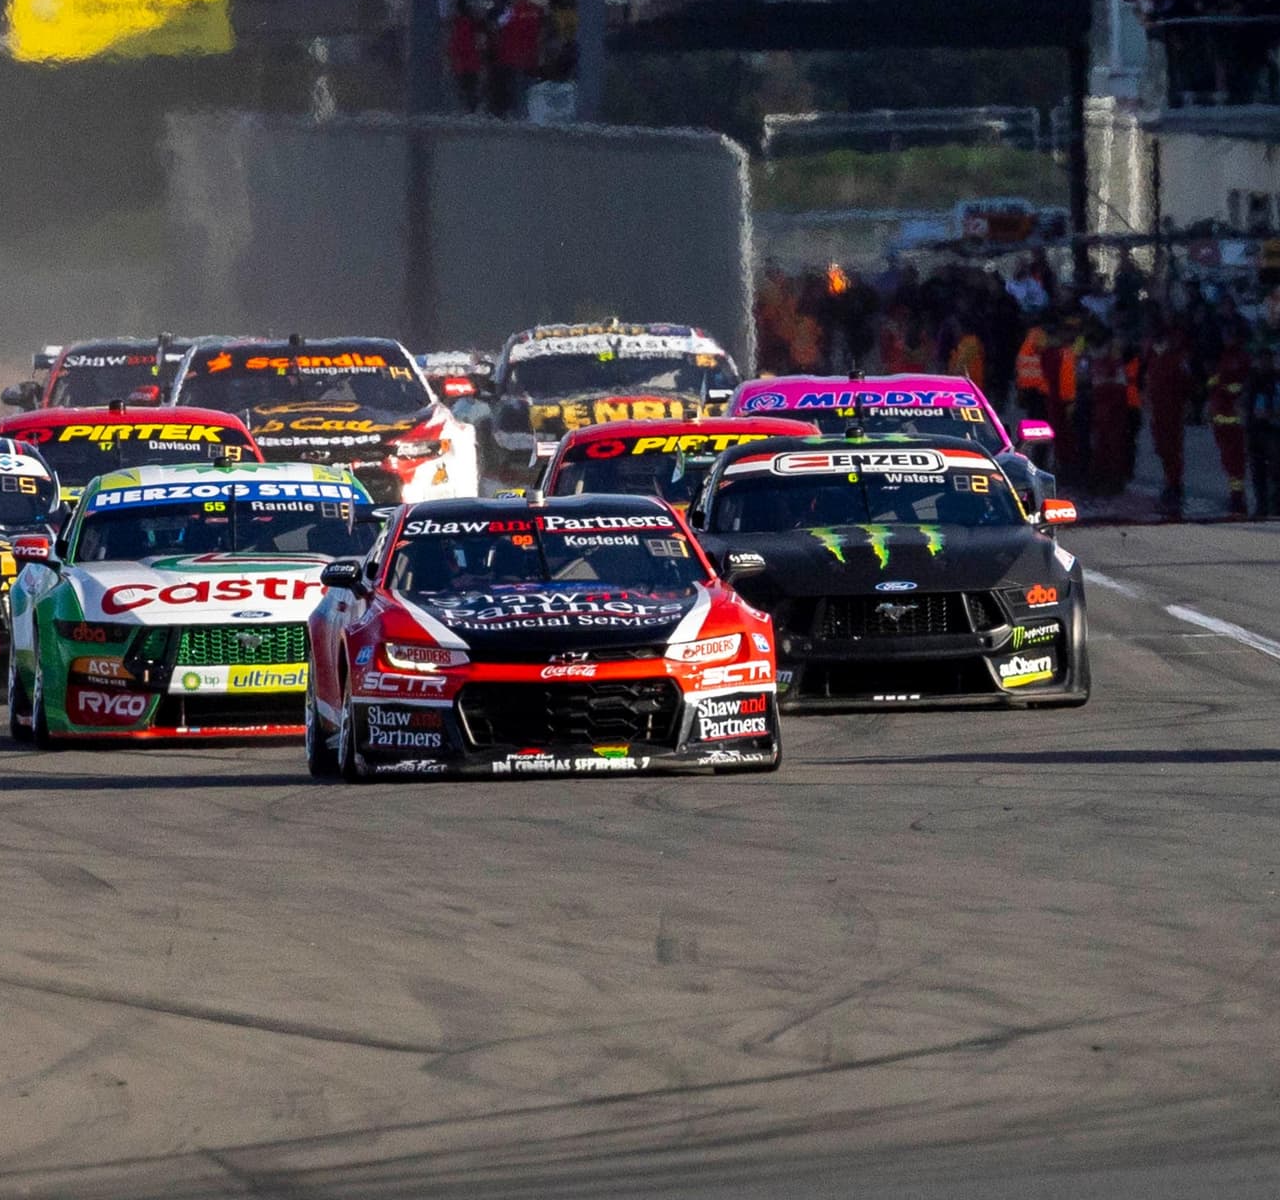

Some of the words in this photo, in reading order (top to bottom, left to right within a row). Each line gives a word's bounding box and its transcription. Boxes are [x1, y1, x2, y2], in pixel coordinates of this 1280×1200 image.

[57, 424, 225, 443] PIRTEK
[148, 439, 201, 452] Davison
[832, 453, 930, 467] ENZED
[884, 472, 946, 484] Waters
[95, 483, 250, 507] HERZOG
[203, 501, 227, 512] 55
[251, 500, 315, 513] Randle
[511, 534, 534, 546] 99
[564, 534, 640, 547] Kostecki
[101, 576, 329, 616] Castr
[1026, 584, 1058, 604] dba
[443, 600, 685, 621] Partners
[446, 614, 572, 632] Financial
[577, 613, 683, 627] Services
[406, 647, 452, 665] PEDDERS
[694, 636, 735, 657] PEDDERS
[87, 659, 121, 676] ACT
[203, 671, 221, 686] bp
[232, 667, 309, 689] ultimat
[77, 690, 148, 717] RYCO
[369, 725, 442, 748] Partners
[699, 716, 766, 741] Partners
